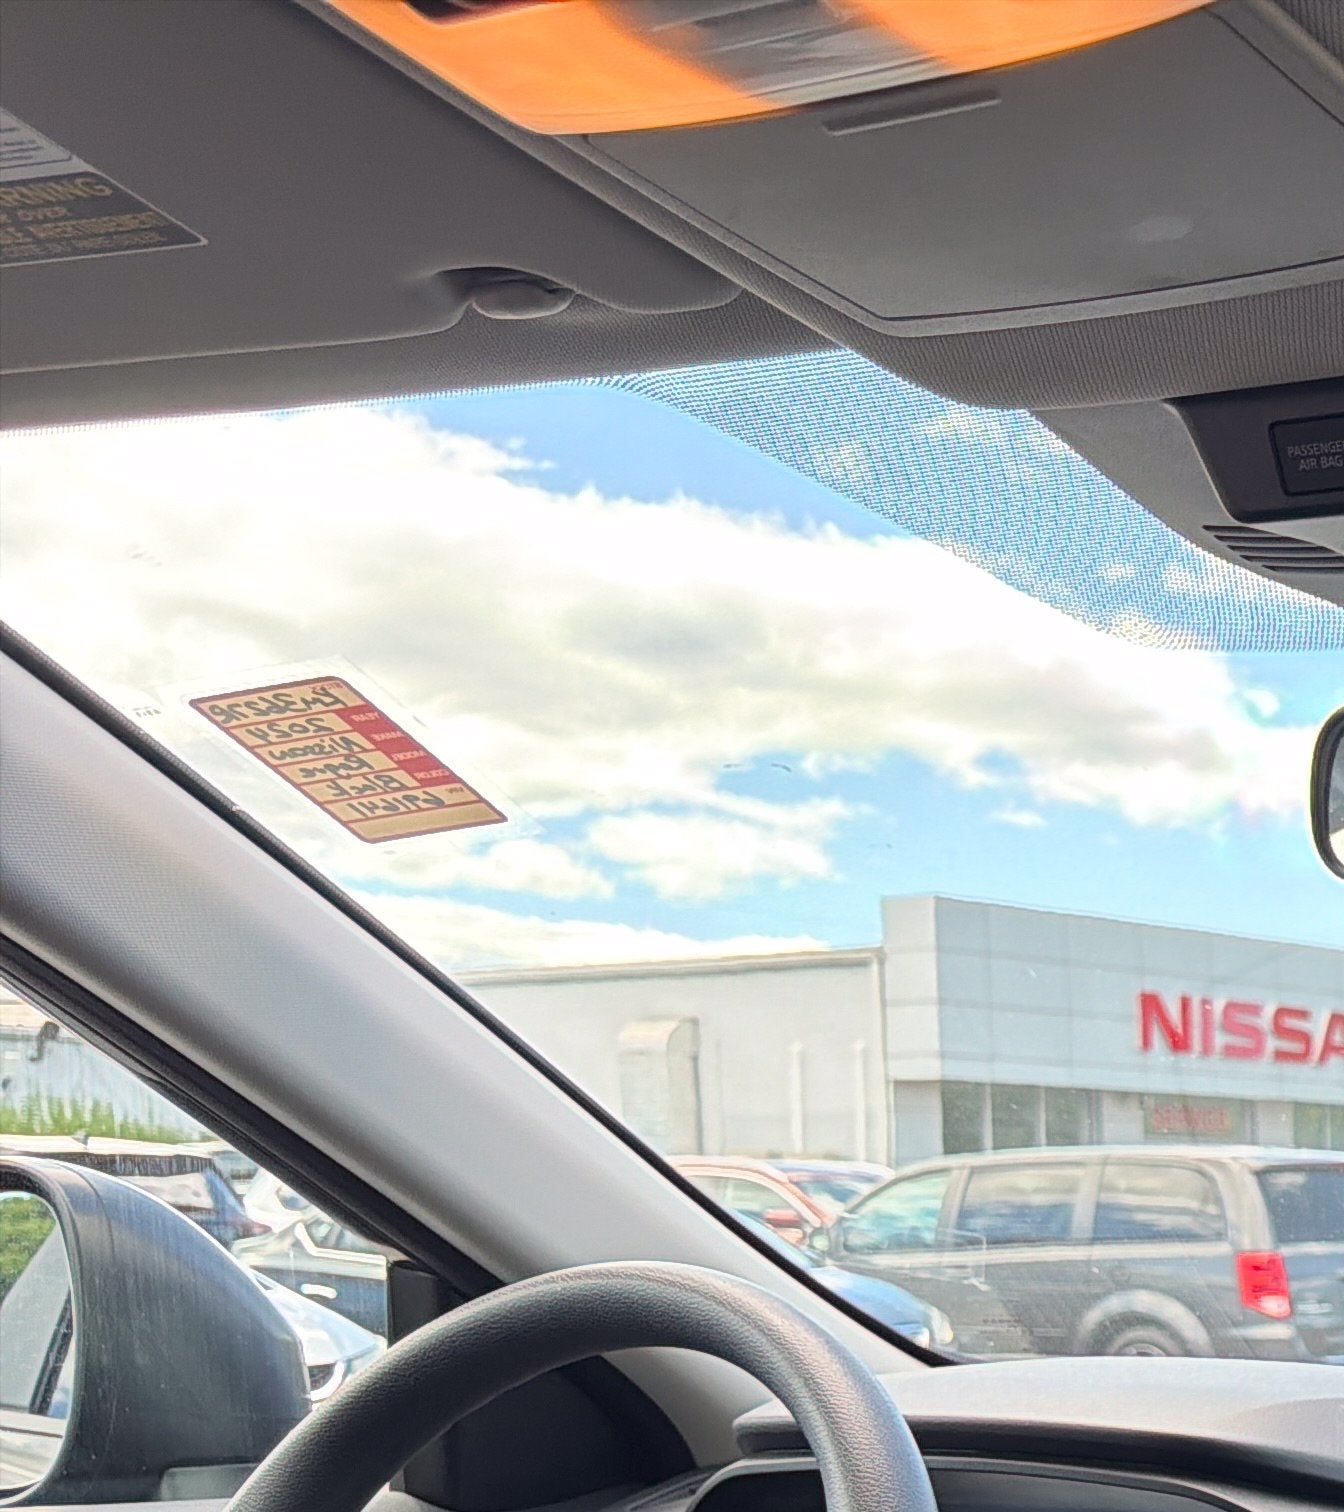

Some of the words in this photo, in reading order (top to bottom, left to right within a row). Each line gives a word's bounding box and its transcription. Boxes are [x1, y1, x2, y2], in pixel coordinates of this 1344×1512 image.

[0, 177, 113, 207] RNING
[1300, 459, 1318, 471] AIR
[1321, 456, 1343, 469] BAG
